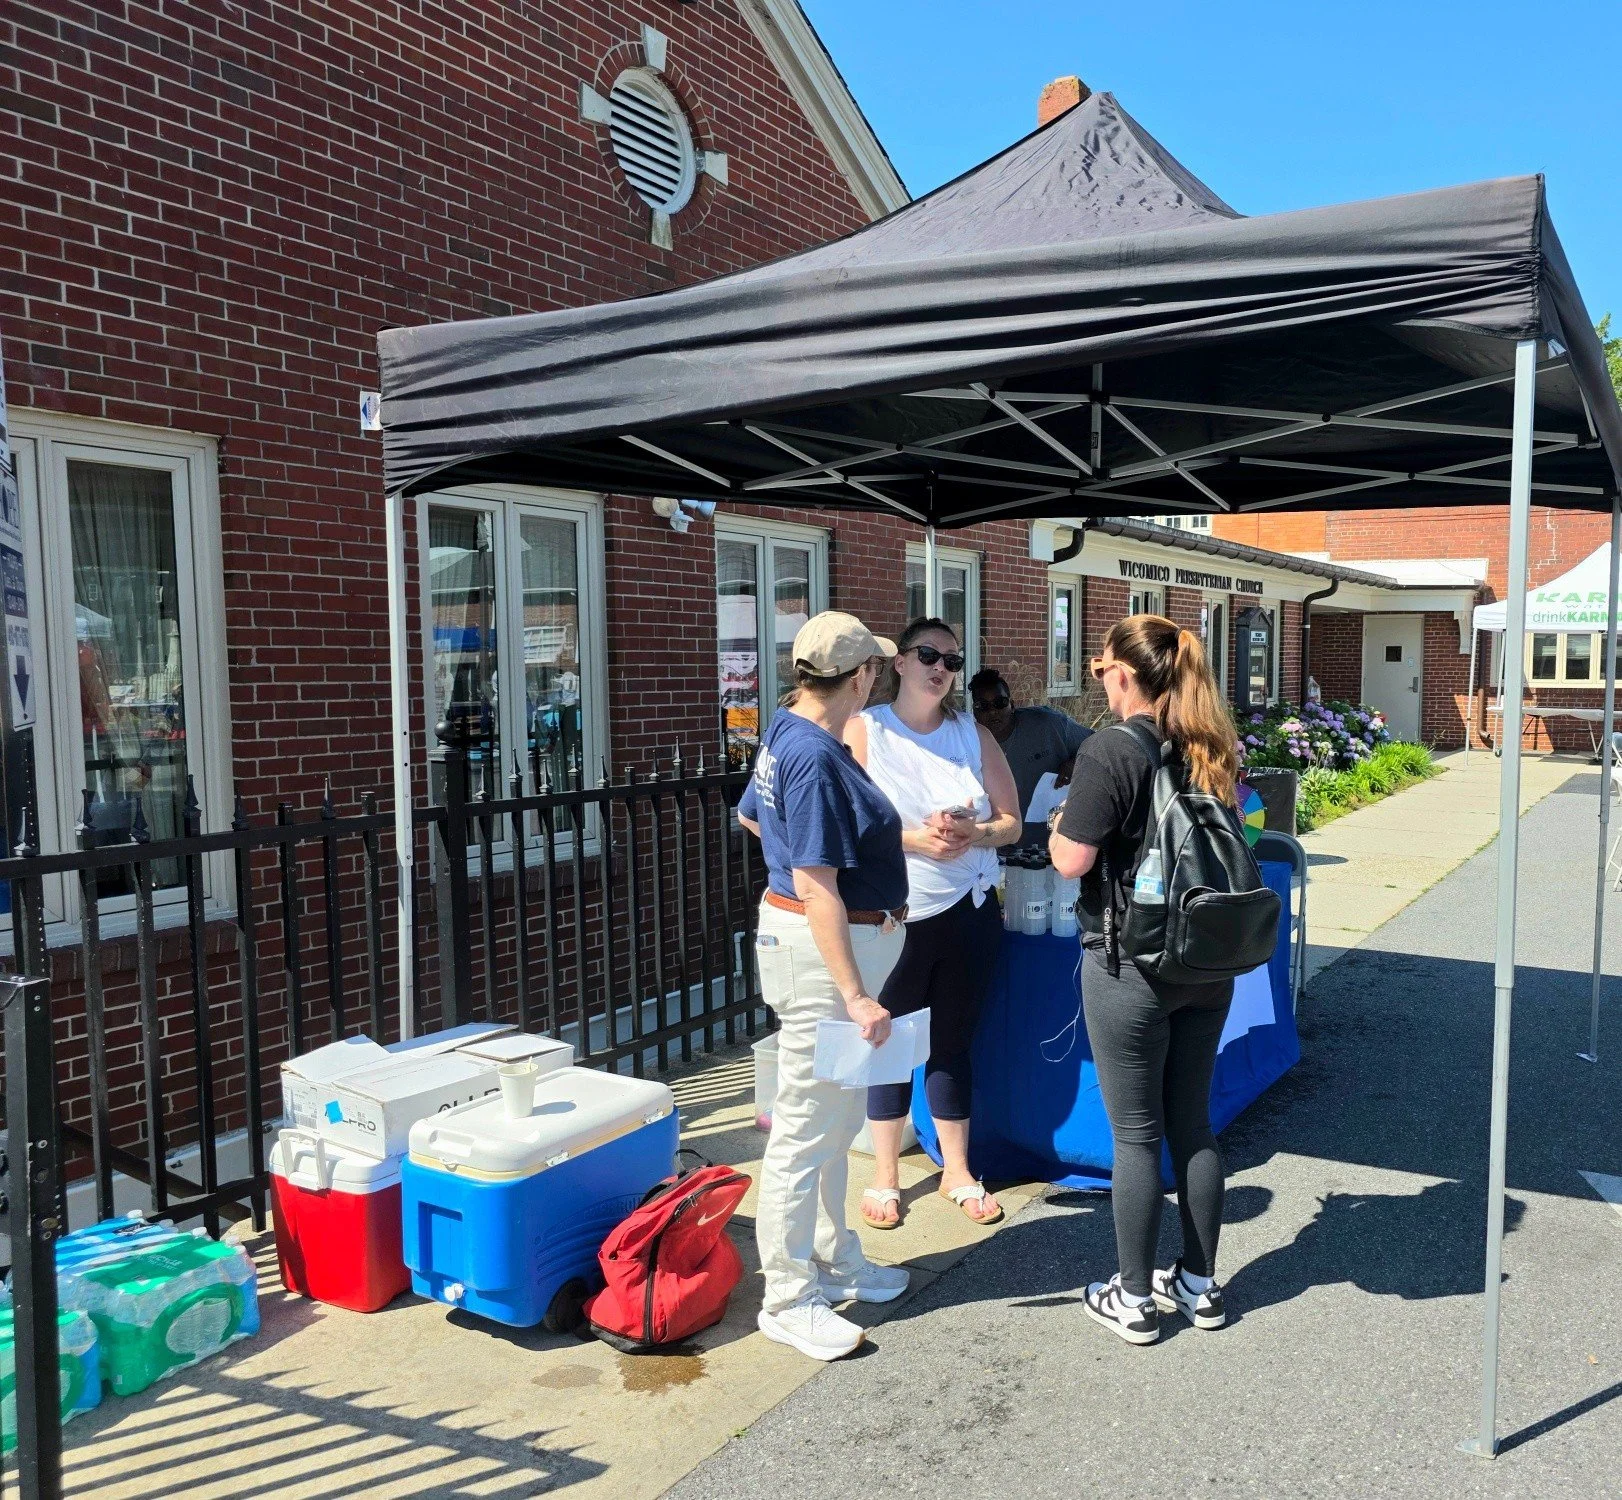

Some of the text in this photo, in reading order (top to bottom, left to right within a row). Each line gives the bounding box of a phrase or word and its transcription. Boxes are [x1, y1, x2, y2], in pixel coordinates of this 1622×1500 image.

[1119, 559, 1263, 594] WICOMICO PRESBYTERIAN CHURCH
[1103, 907, 1112, 954] Calvin Klein
